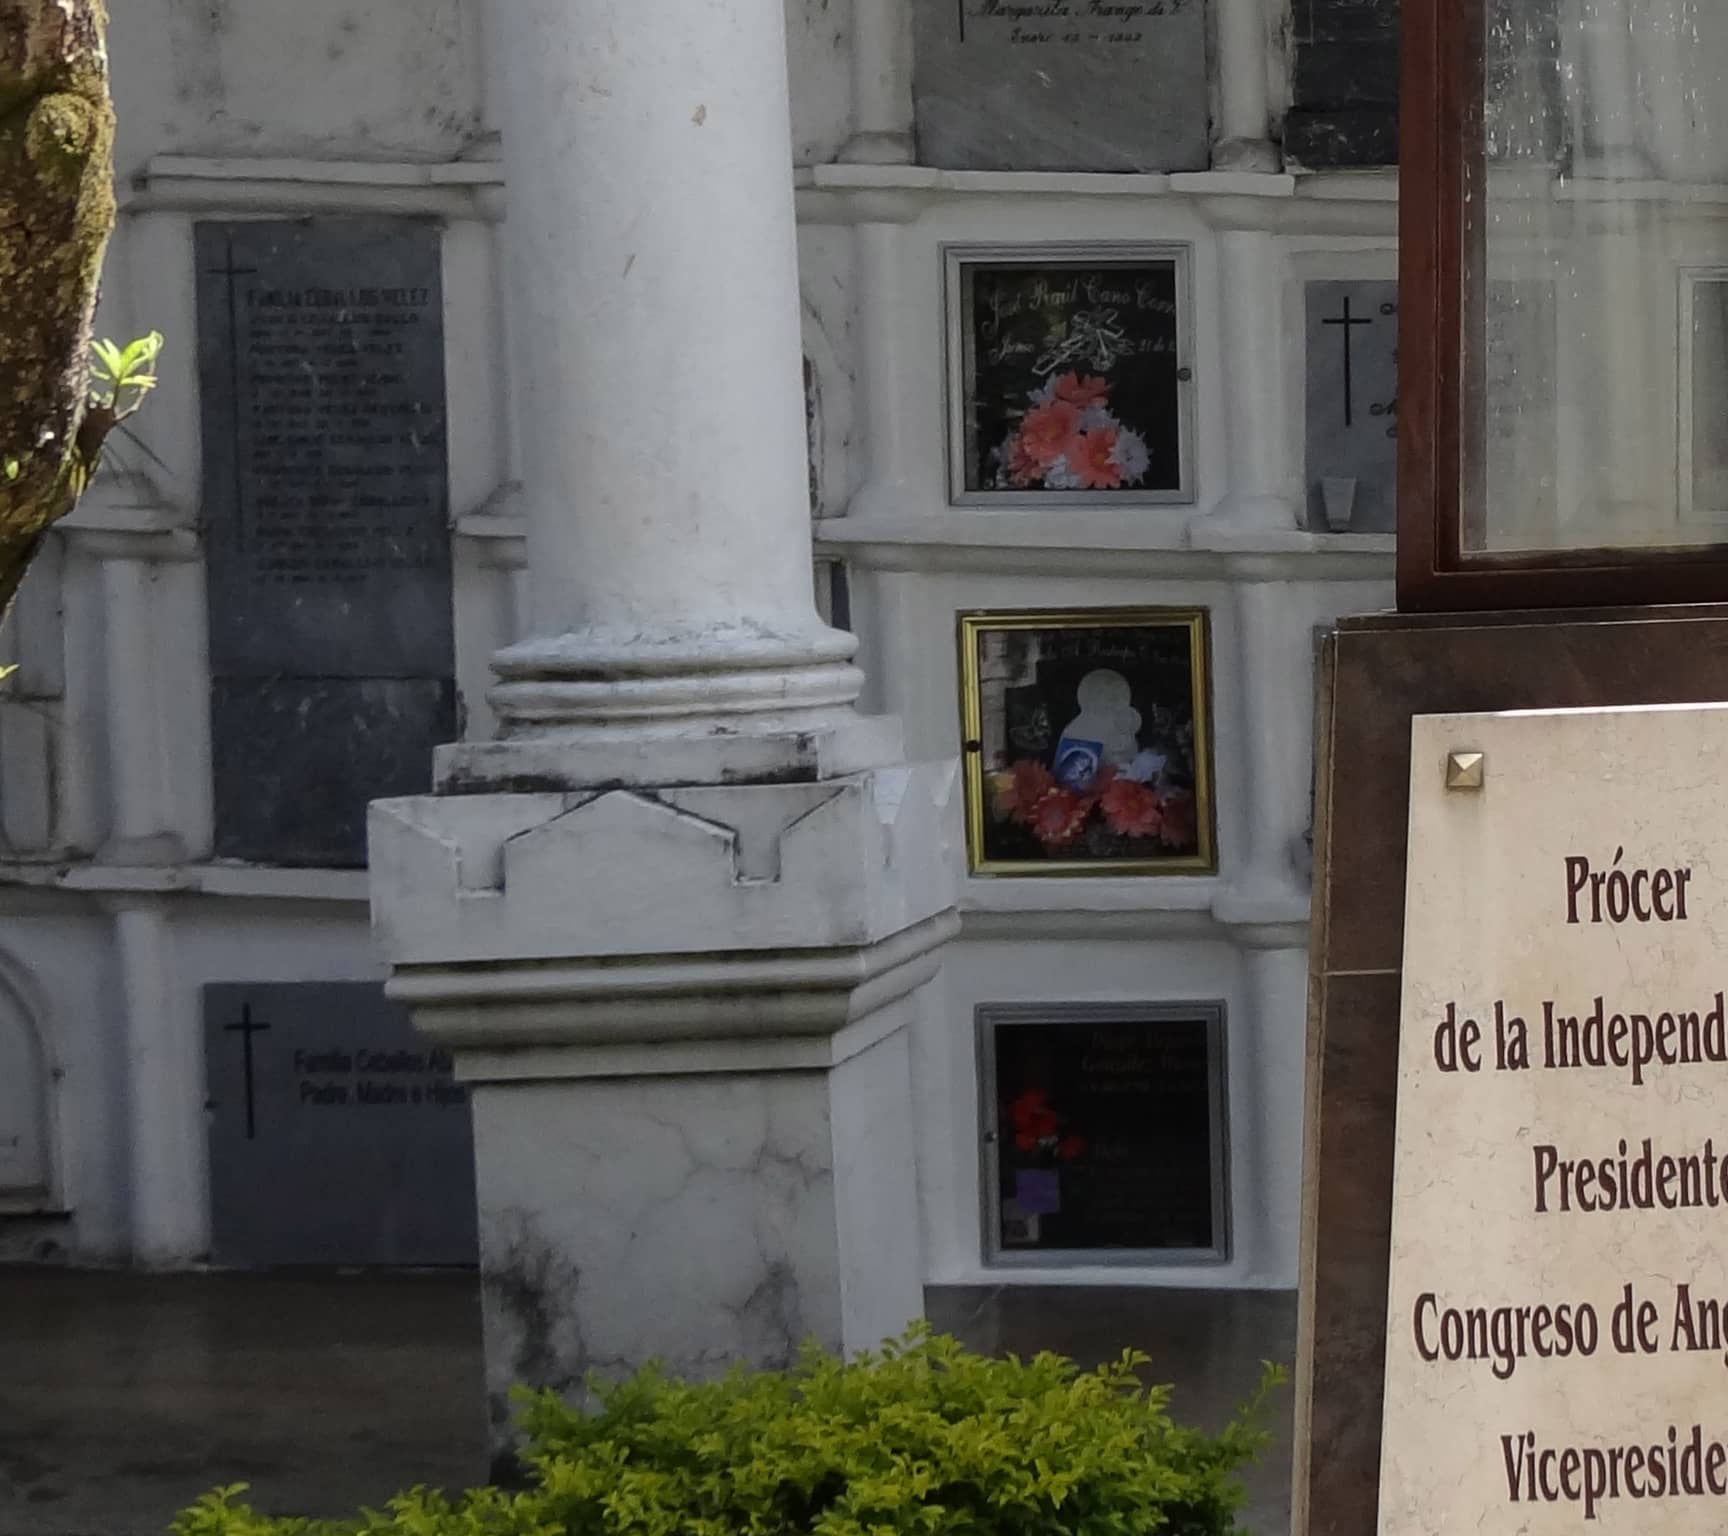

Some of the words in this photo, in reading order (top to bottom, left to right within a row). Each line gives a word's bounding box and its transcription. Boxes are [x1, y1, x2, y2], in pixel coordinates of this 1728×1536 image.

[1564, 845, 1692, 924] Prócer
[1434, 1001, 1482, 1073] de
[1494, 999, 1530, 1071] la
[1413, 1292, 1598, 1380] Congreso
[1611, 1283, 1659, 1354] de
